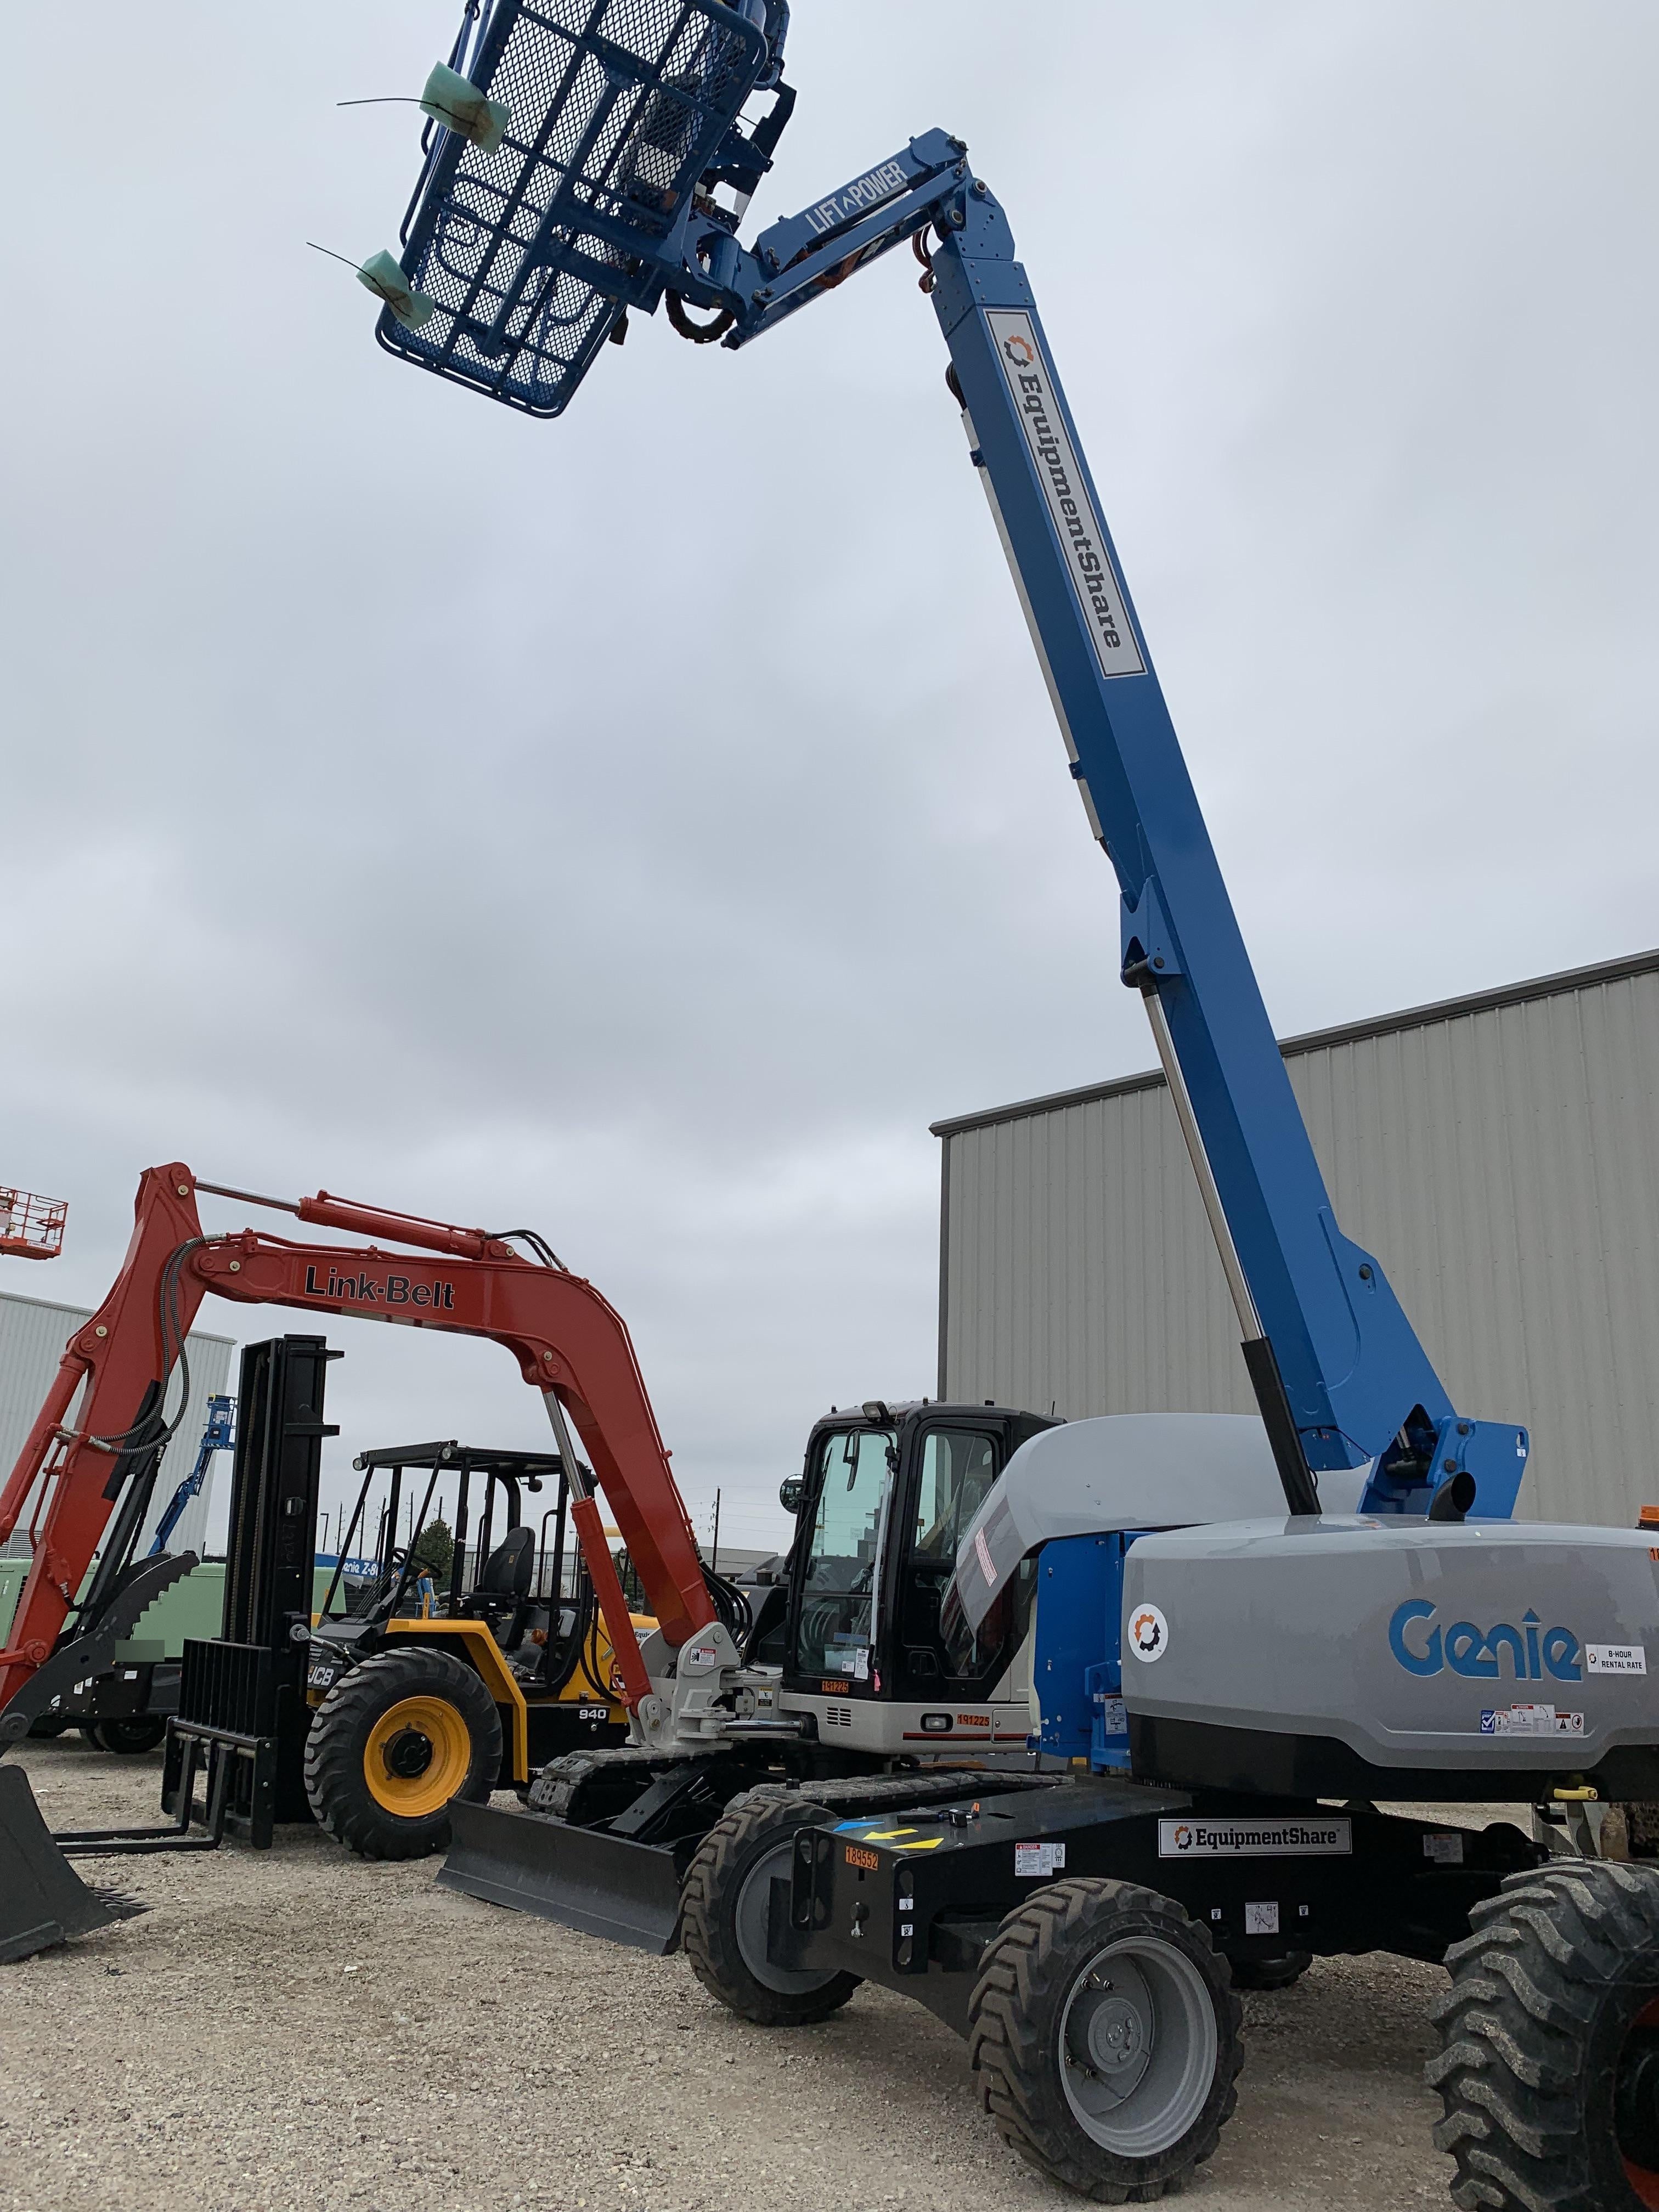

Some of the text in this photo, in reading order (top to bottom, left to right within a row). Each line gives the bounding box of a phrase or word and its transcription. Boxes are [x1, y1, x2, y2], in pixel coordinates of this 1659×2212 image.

[805, 161, 908, 234] LIFT POWER
[1018, 374, 1121, 648] EquipmentShare
[305, 1265, 455, 1310] Link-Belt
[342, 1561, 359, 1573] enie
[1389, 1599, 1583, 1682] Genie
[308, 1666, 334, 1686] JCB
[823, 1681, 848, 1691] 191225
[579, 1709, 606, 1719] 940
[957, 1714, 990, 1726] 191225
[1195, 1827, 1337, 1850] EquipmentShare
[848, 1847, 877, 1868] 189552
